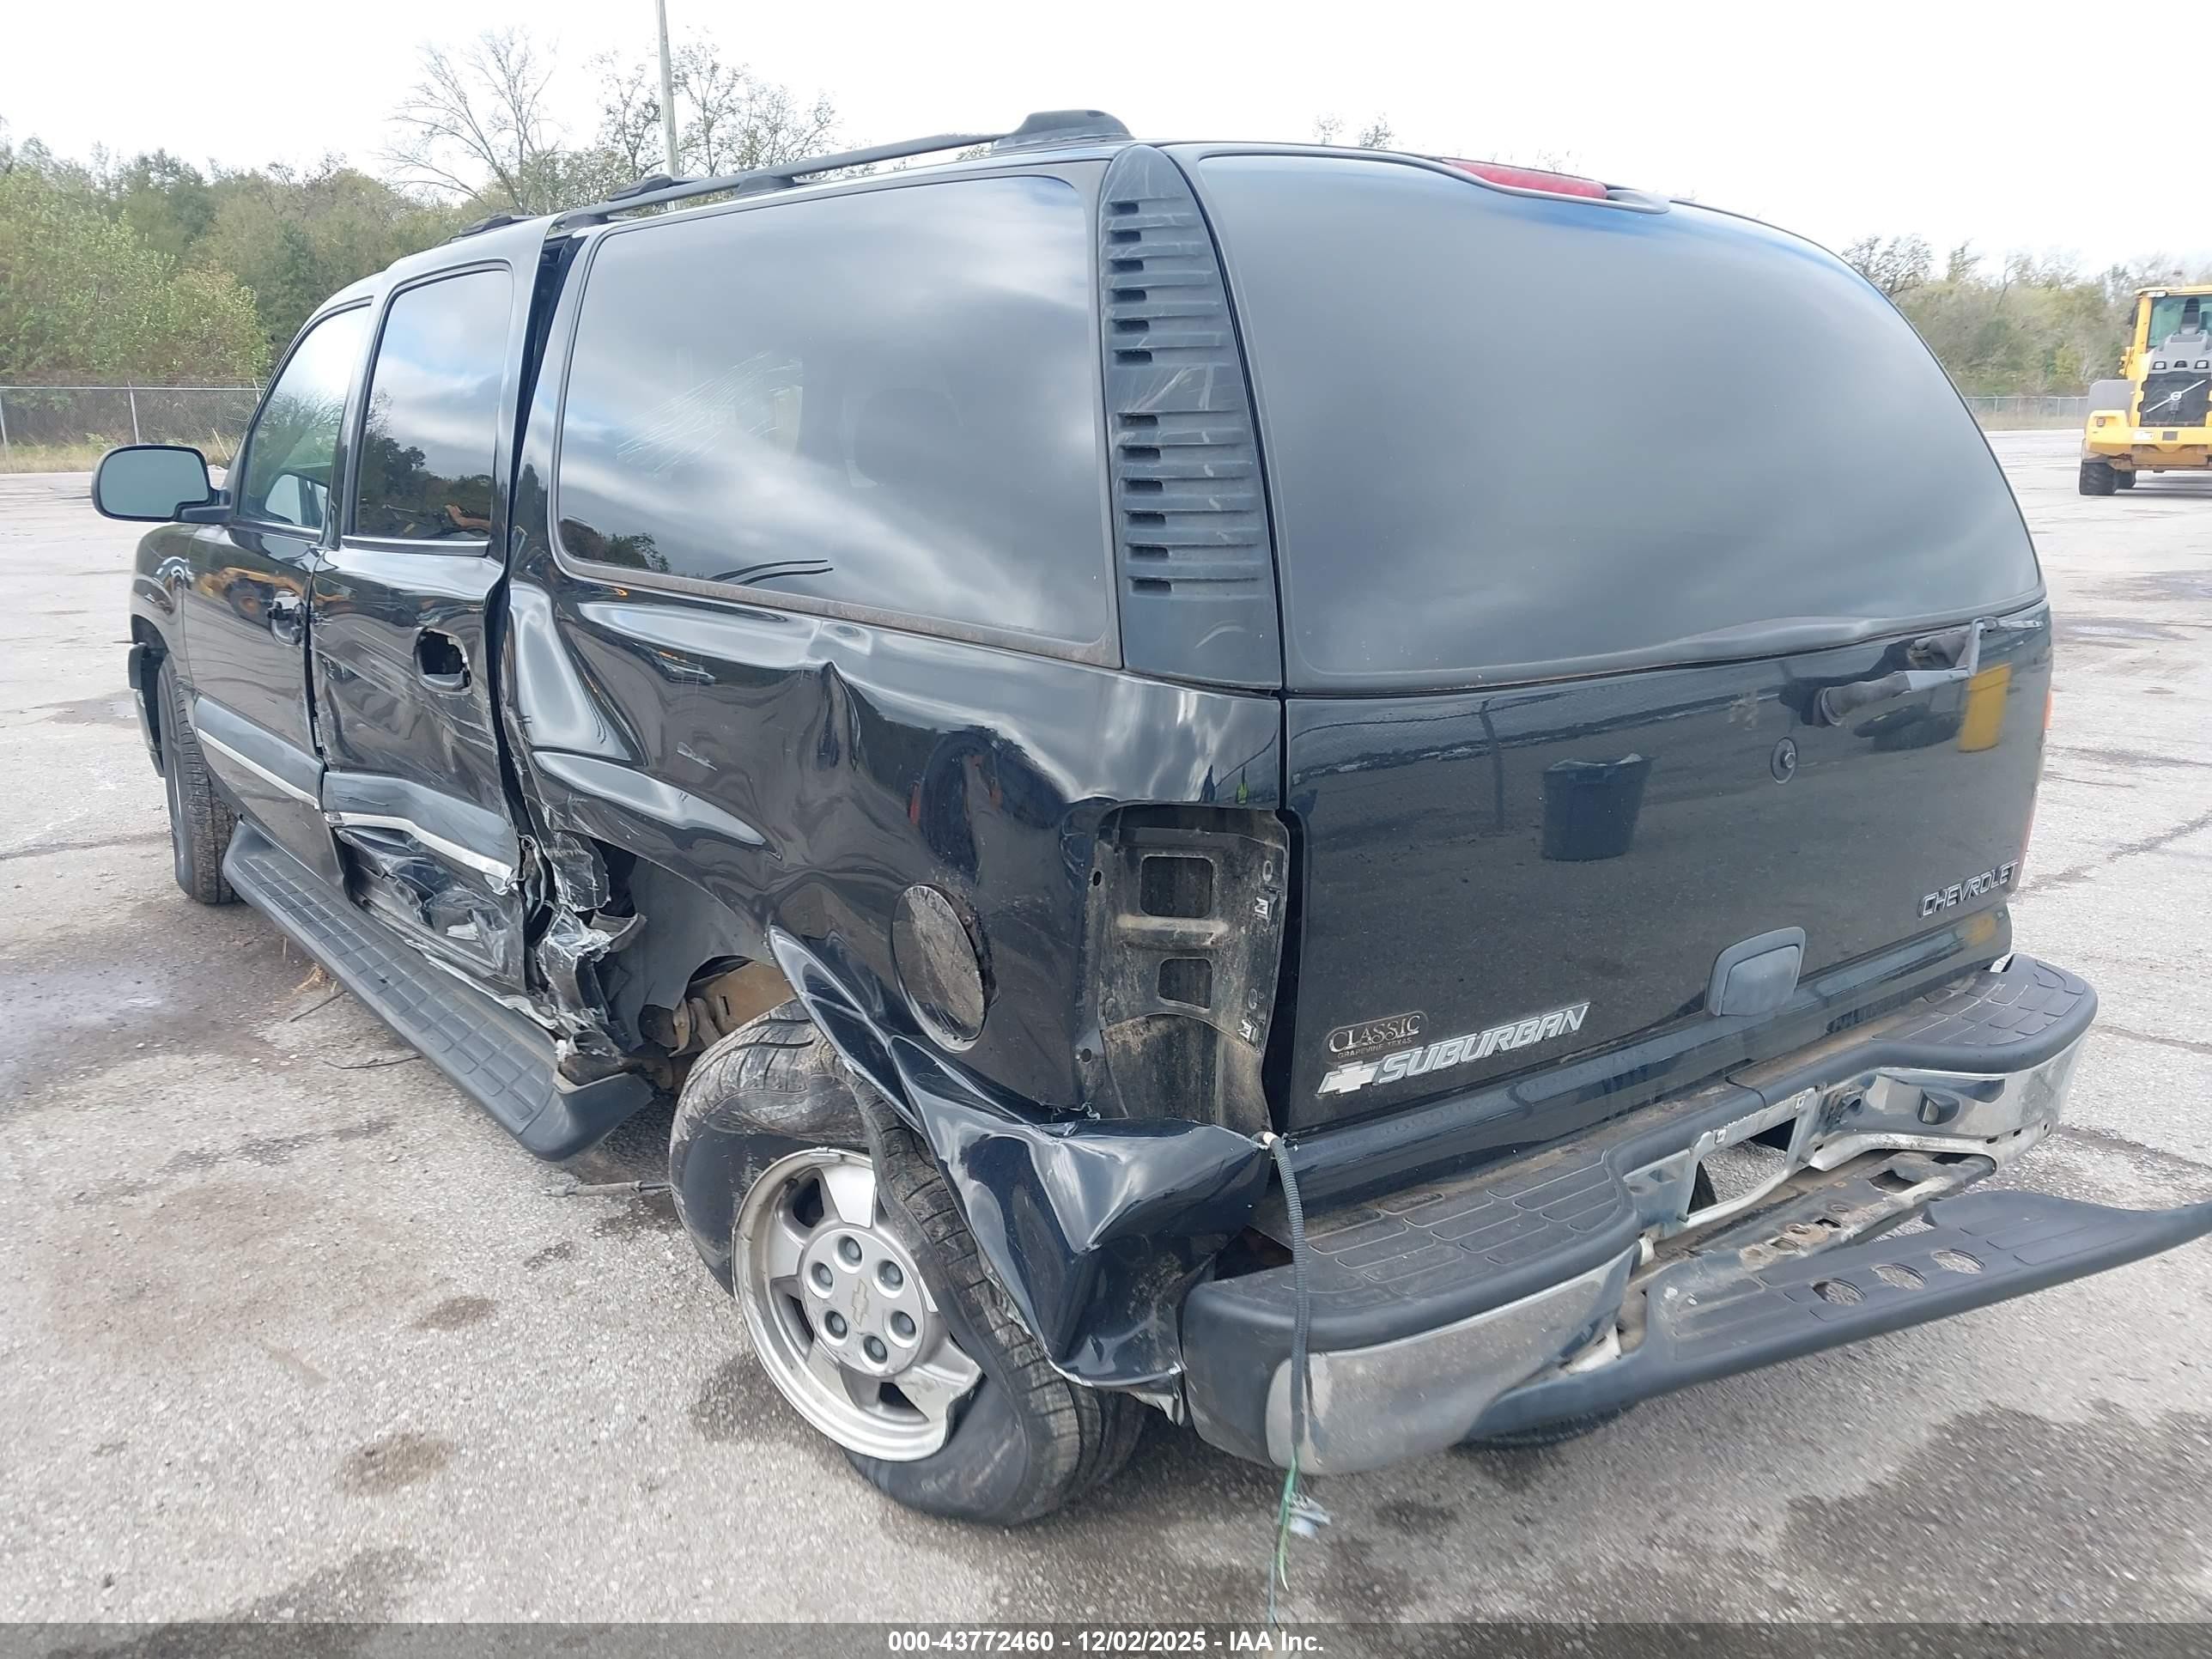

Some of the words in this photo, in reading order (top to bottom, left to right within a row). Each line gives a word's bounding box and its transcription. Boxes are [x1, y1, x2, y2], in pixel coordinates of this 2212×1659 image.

[1919, 860, 2019, 917] CHEVROLET
[1328, 1015, 1420, 1053] CLASSIC
[1376, 1003, 1589, 1085] SUBURBAN
[1388, 1036, 1413, 1047] TEXAS
